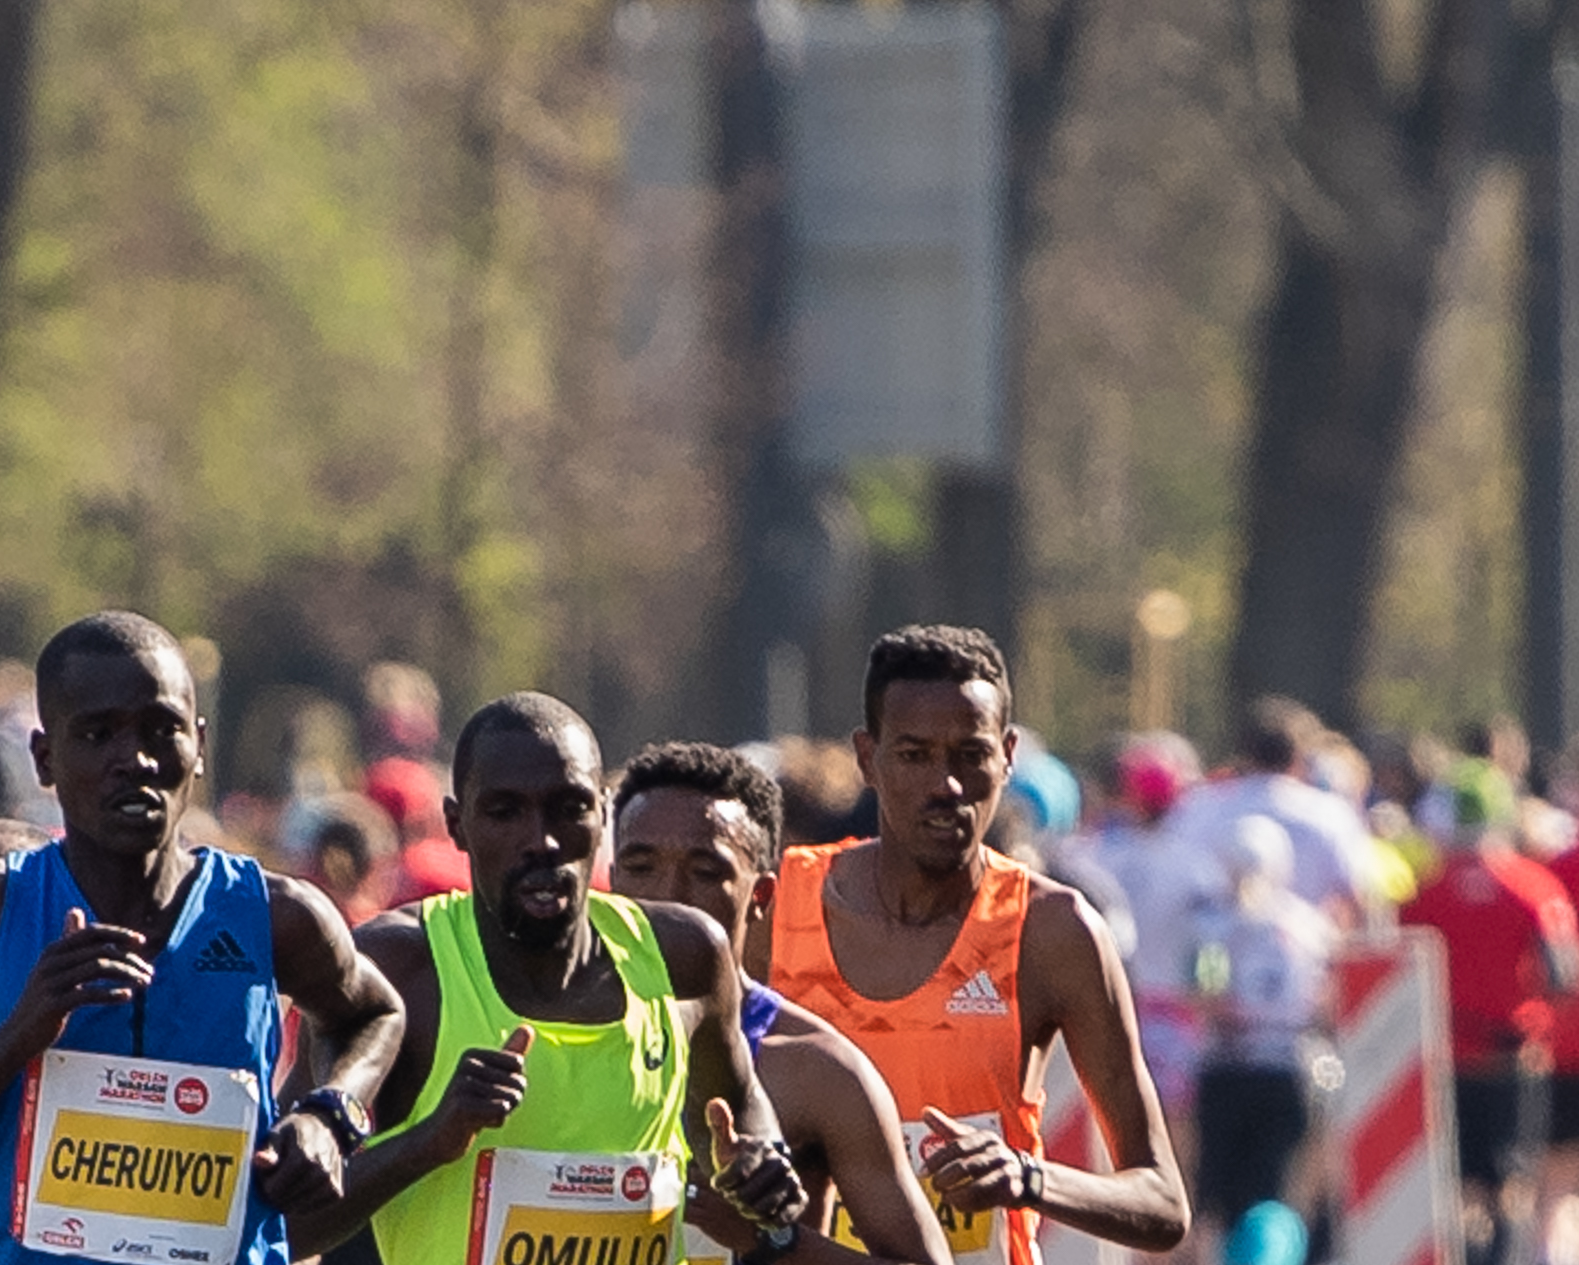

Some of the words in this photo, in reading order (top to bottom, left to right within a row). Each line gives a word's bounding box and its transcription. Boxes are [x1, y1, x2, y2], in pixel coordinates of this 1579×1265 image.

[193, 957, 258, 974] adidas
[945, 999, 1008, 1014] adidas
[51, 1137, 233, 1199] CHERUIYOT
